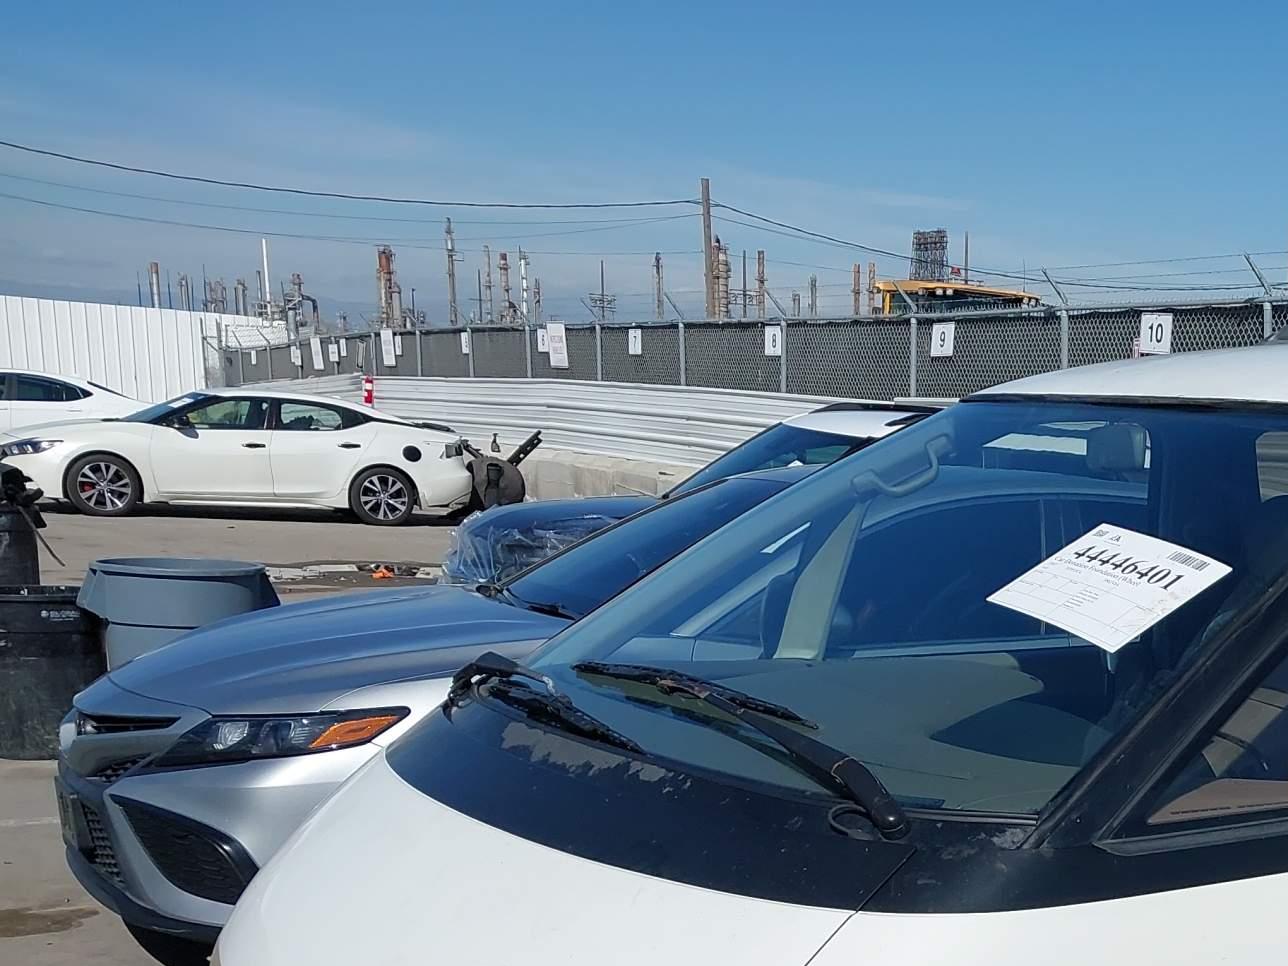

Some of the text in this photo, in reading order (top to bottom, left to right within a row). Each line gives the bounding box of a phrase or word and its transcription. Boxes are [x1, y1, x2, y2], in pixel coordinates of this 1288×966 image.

[771, 333, 777, 348] 8
[938, 332, 946, 348] 9
[1148, 322, 1164, 344] 10
[1073, 545, 1185, 591] 44446401
